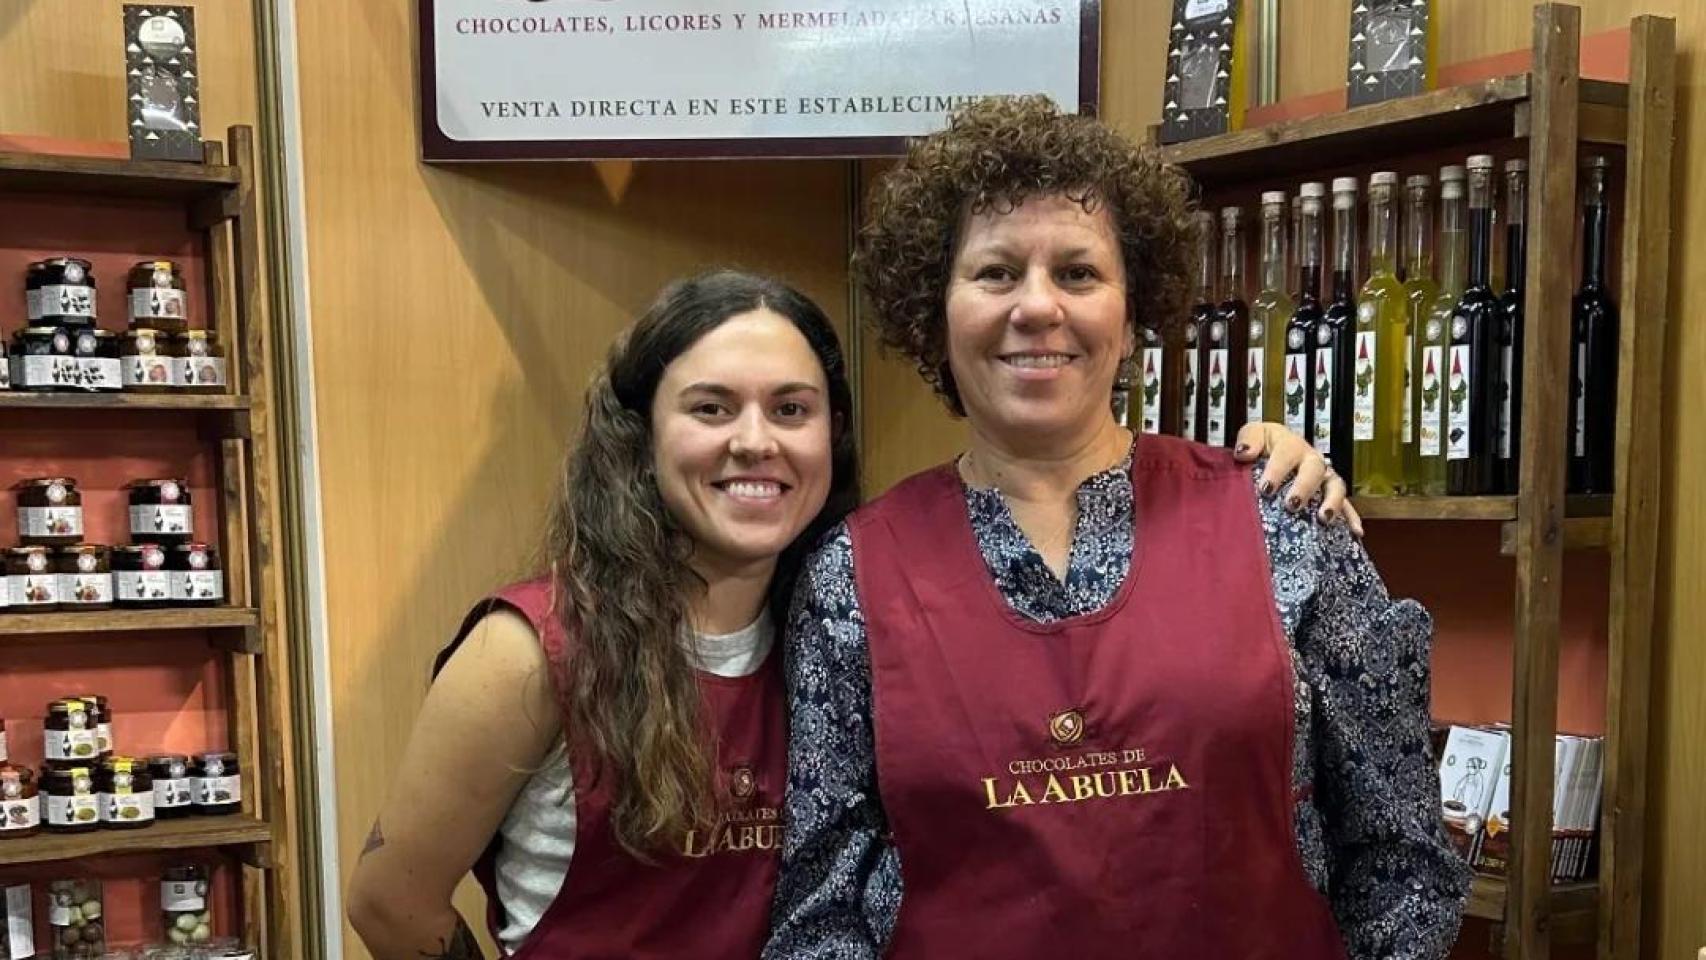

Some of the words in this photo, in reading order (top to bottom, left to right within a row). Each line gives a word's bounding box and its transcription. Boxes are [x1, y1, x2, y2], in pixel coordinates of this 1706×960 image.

[456, 16, 614, 35] CHOCOLATES,
[626, 14, 722, 32] LICORES
[733, 13, 746, 31] Y
[480, 101, 560, 118] VENTA
[570, 99, 677, 117] DIRECTA
[688, 98, 719, 116] EN
[730, 97, 788, 115] ESTE
[1008, 751, 1118, 775] CHOCOLATES
[1122, 748, 1146, 765] DE
[980, 776, 1036, 810] LA
[1039, 762, 1190, 804] ABUELA
